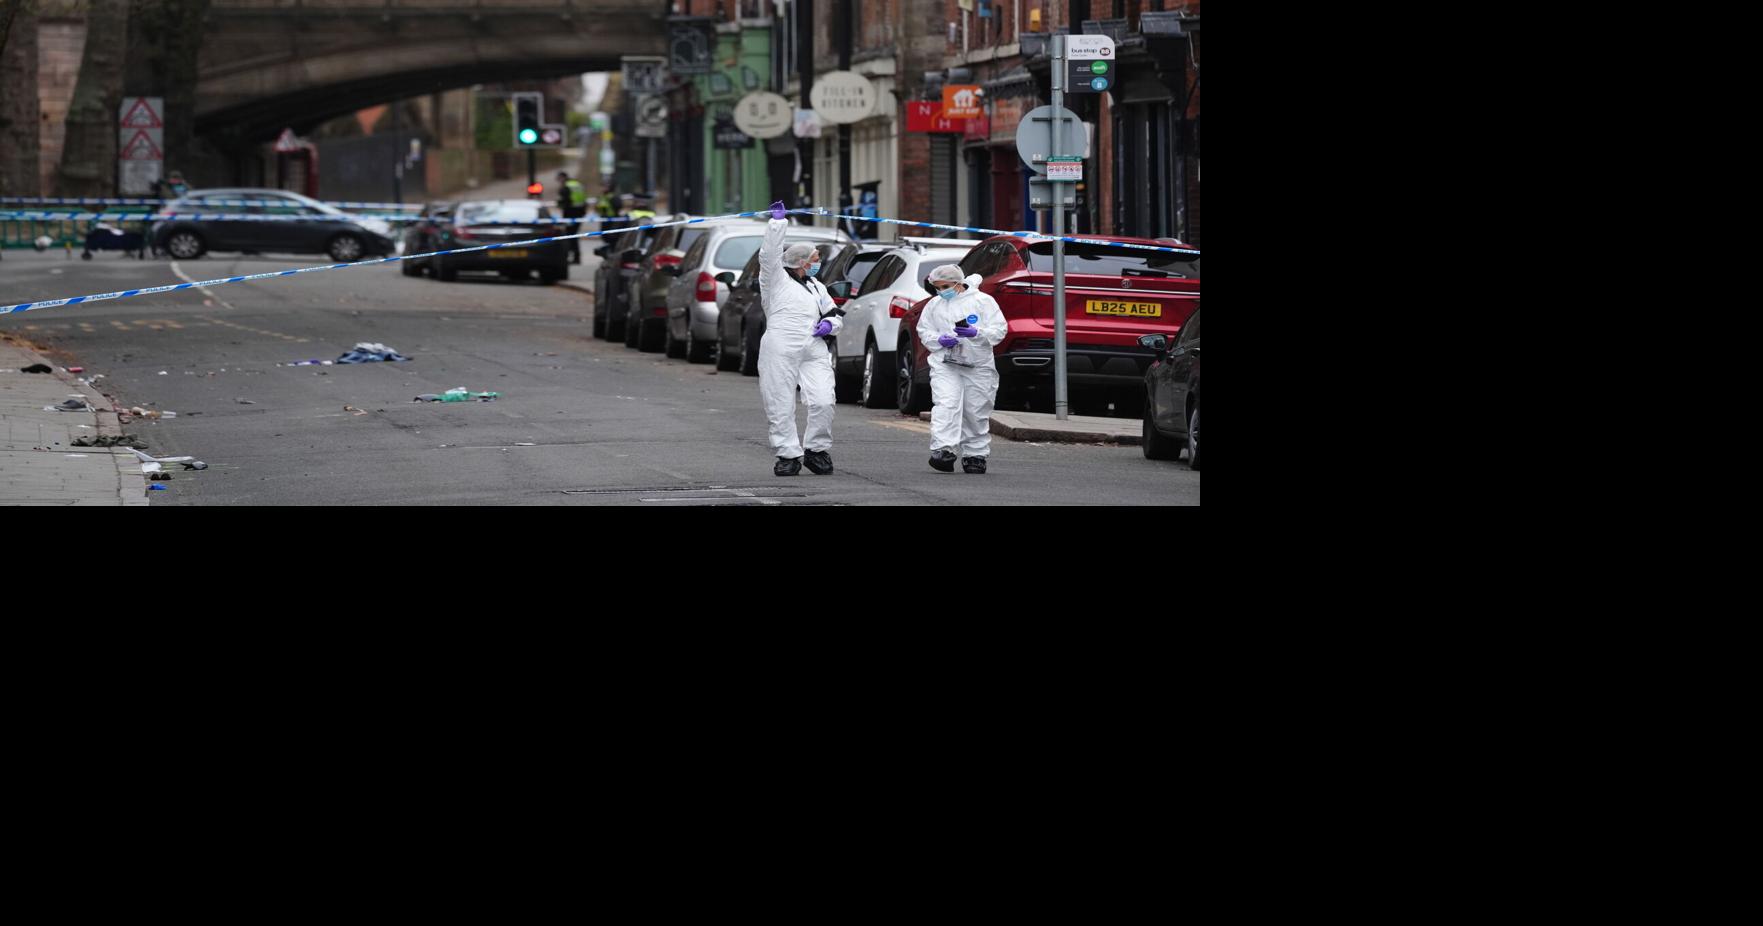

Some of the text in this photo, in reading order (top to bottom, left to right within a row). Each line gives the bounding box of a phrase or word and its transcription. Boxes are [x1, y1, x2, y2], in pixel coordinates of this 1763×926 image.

[822, 98, 865, 109] KITCHEN
[919, 105, 931, 116] N
[939, 119, 951, 129] H
[37, 299, 64, 307] POLICE
[91, 293, 117, 301] POLICE
[1092, 302, 1156, 315] LB25 AEU
